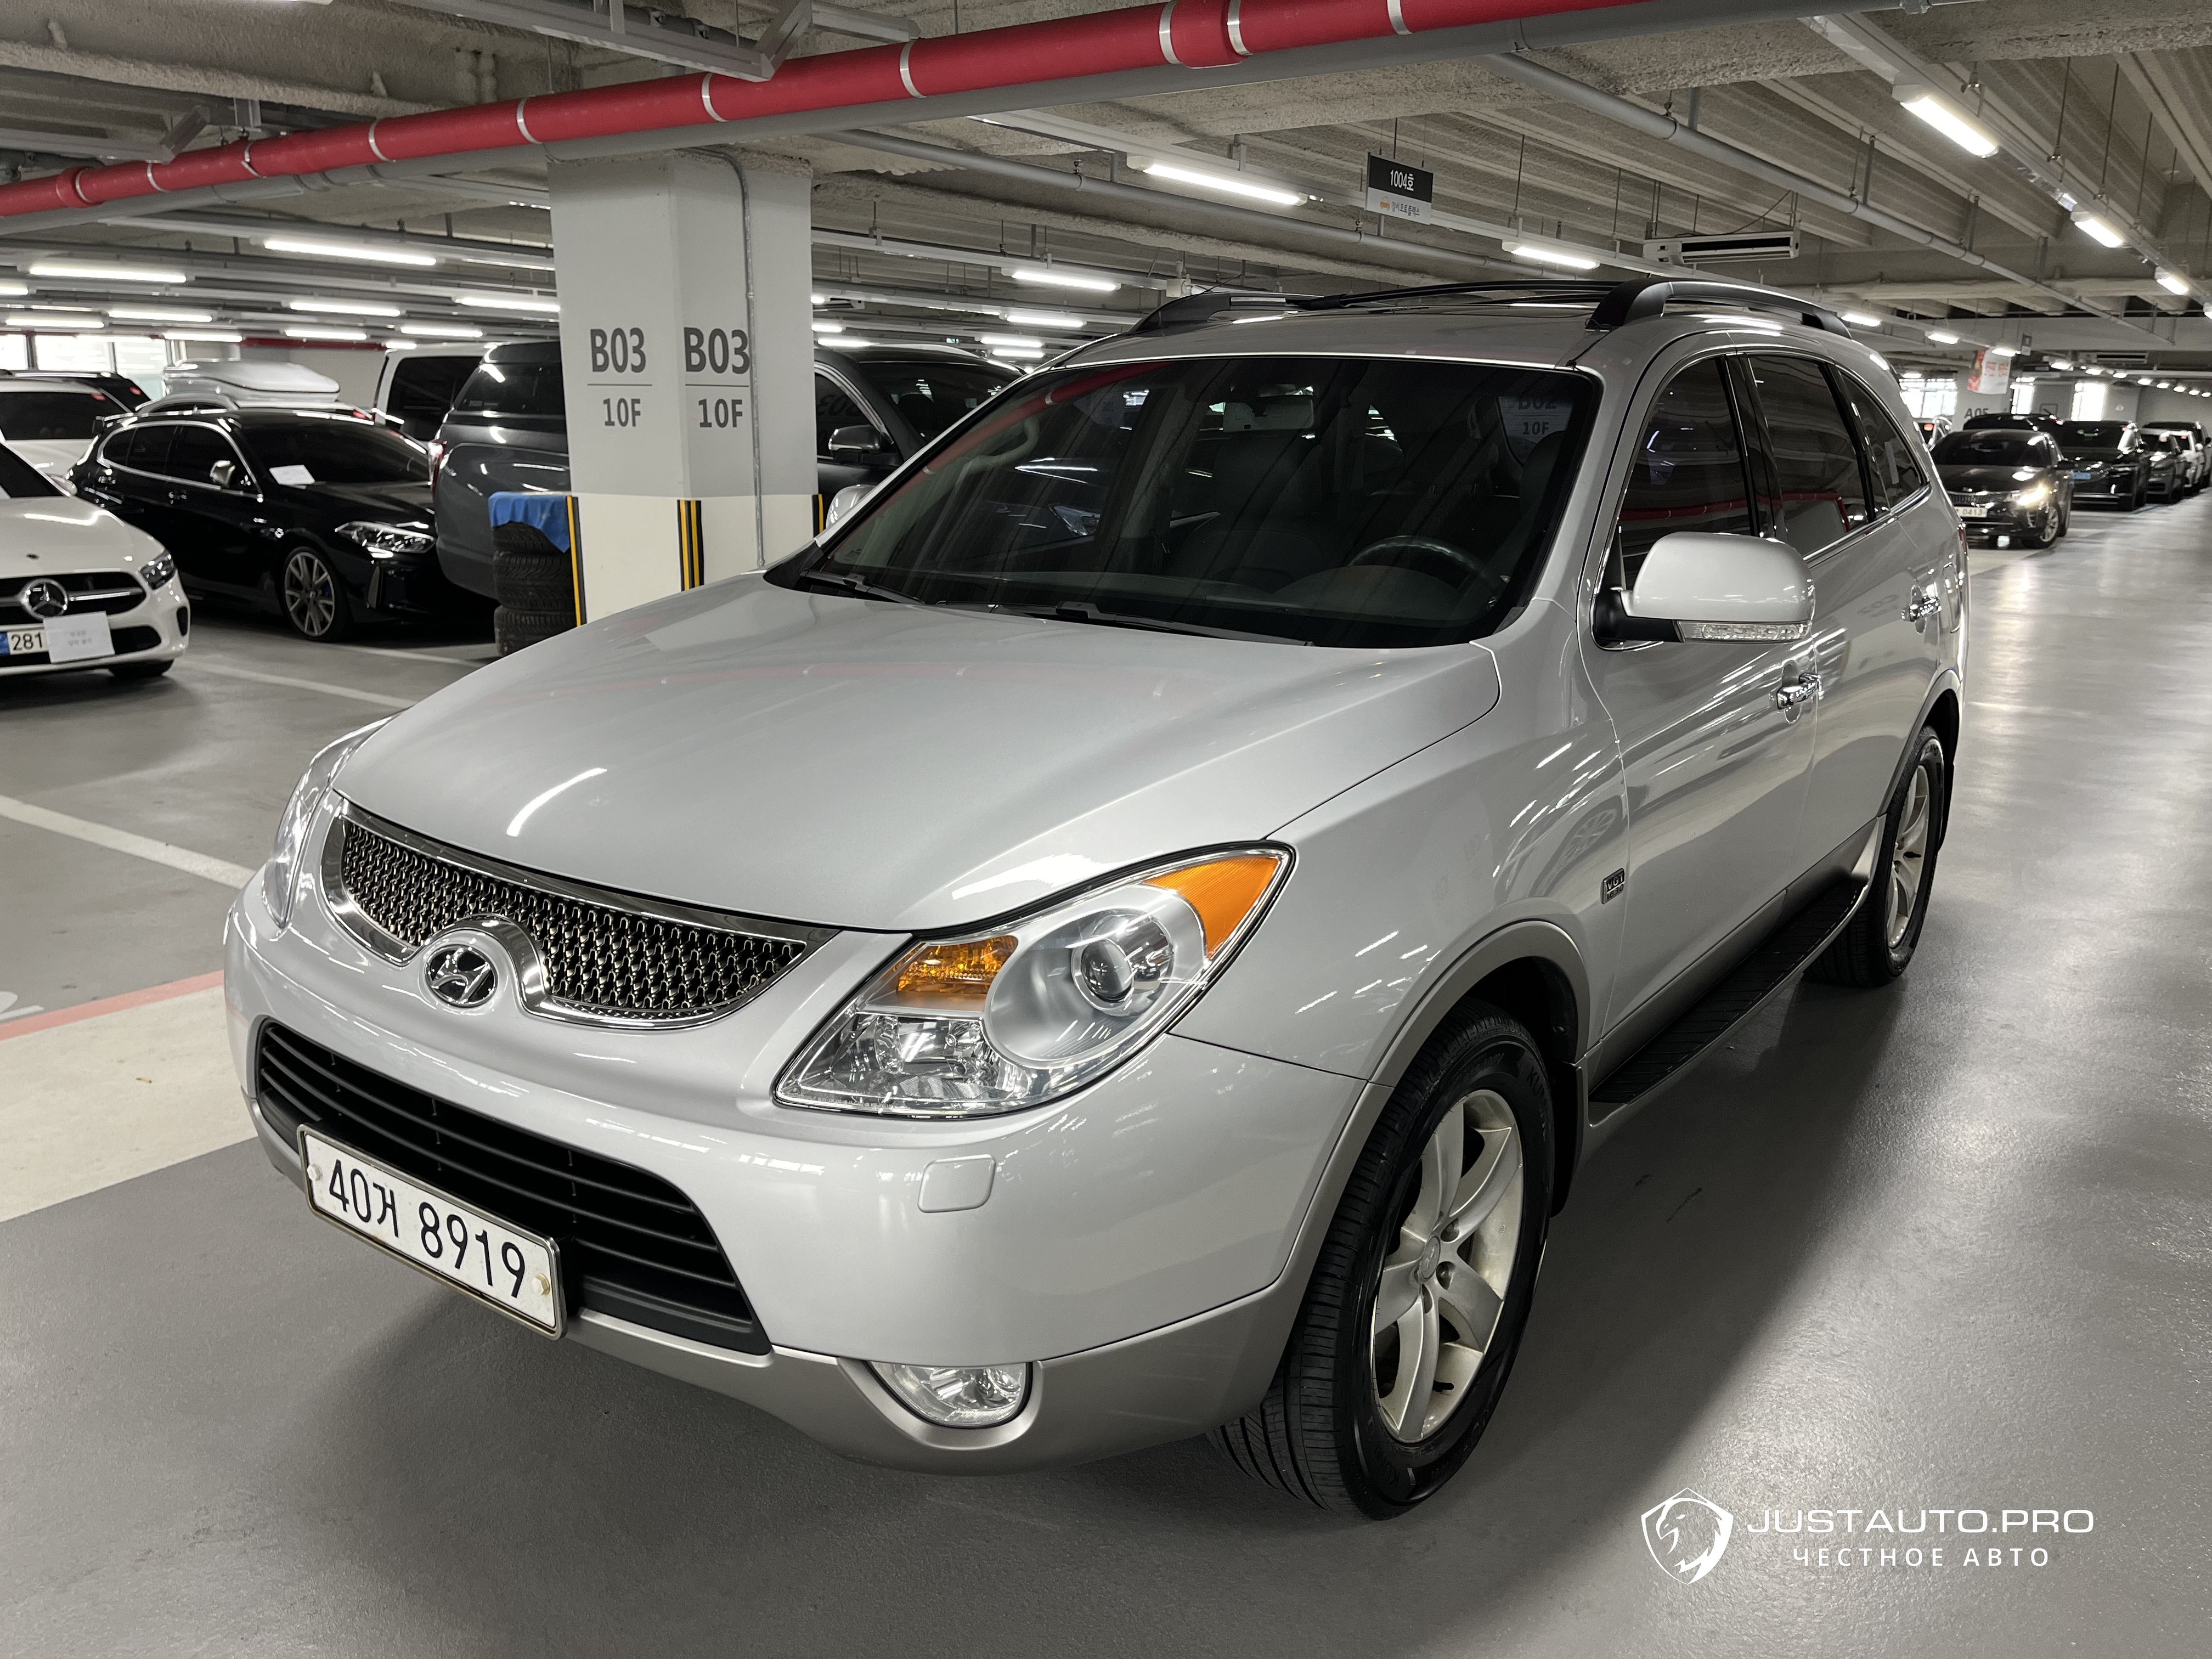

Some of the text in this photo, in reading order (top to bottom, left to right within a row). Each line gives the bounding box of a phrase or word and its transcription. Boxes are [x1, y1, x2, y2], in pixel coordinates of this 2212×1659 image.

[1390, 170, 1414, 191] 1004호
[590, 328, 646, 373] B03
[684, 327, 750, 374] B03
[603, 398, 641, 427] 10F
[698, 398, 743, 427] 10F
[1522, 421, 1550, 435] 10F
[11, 632, 43, 651] 281
[1607, 872, 1624, 890] VGT
[329, 1159, 526, 1299] 40거 8919
